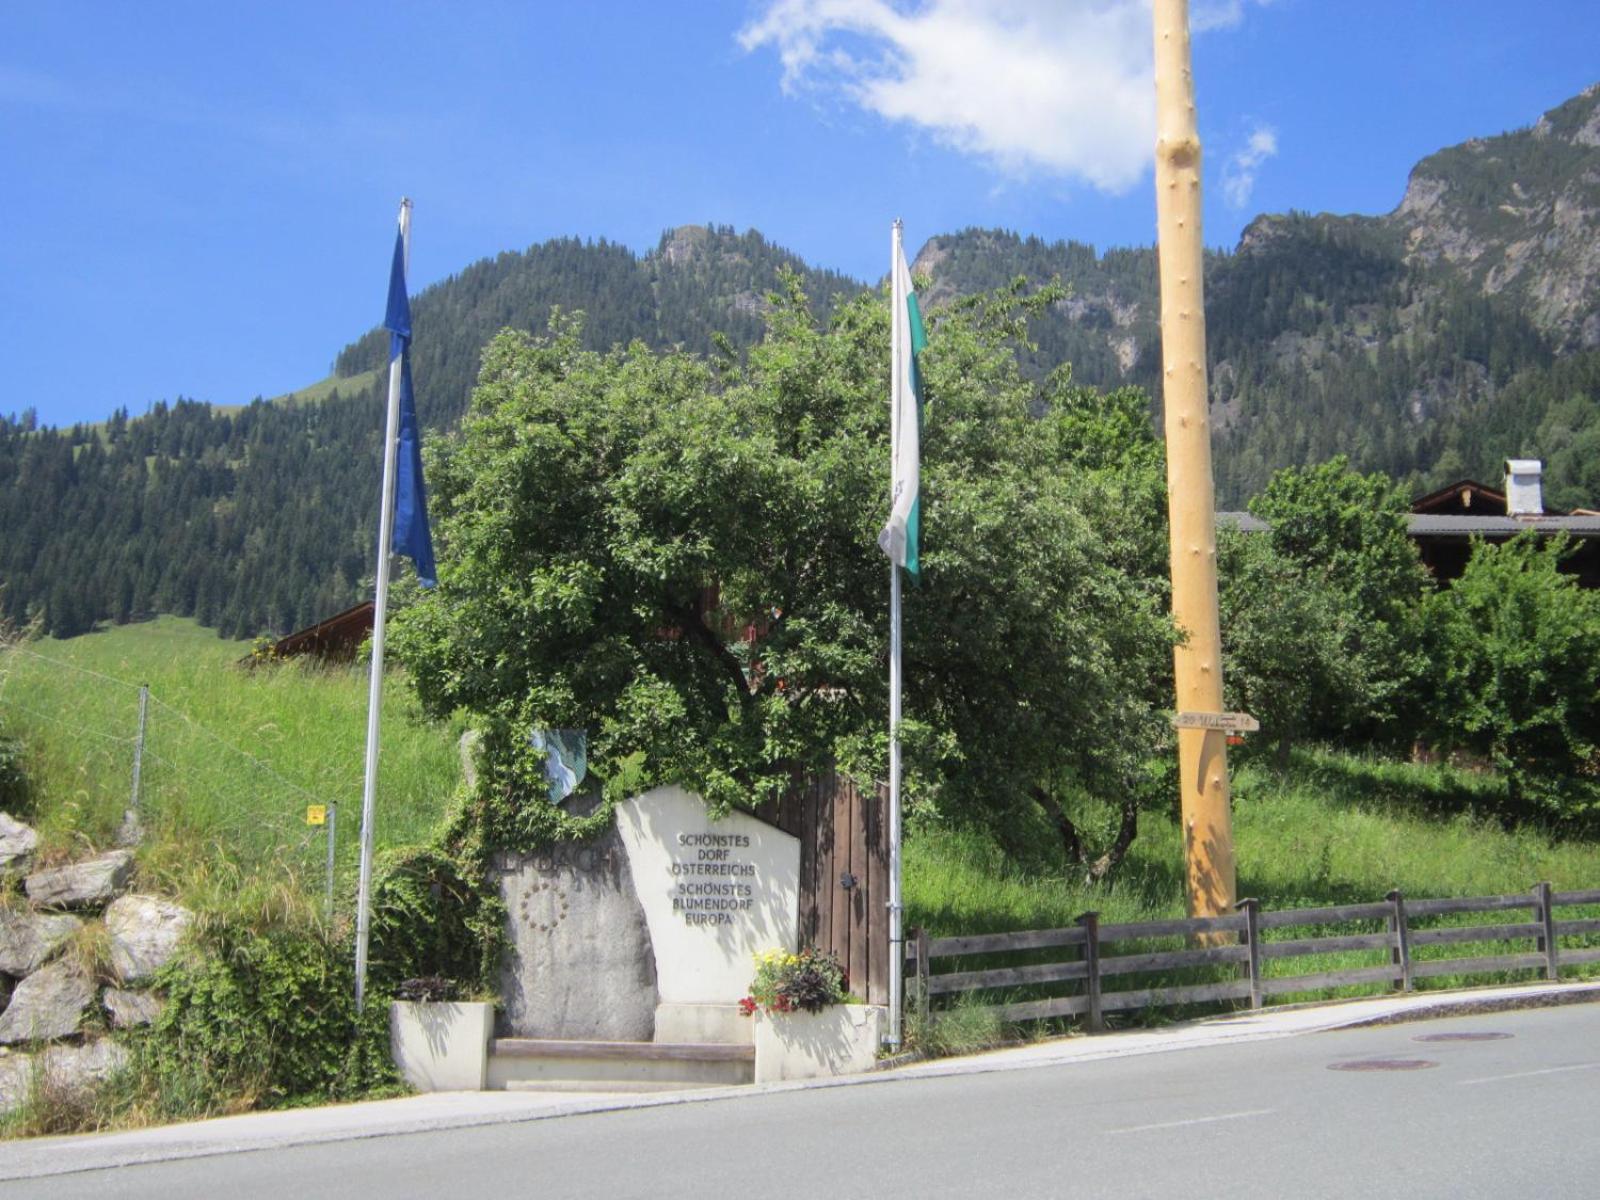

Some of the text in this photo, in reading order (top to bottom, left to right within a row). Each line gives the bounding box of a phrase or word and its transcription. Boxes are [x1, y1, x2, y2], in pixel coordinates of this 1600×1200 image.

[679, 833, 750, 847] SCHÖNSTES
[698, 849, 730, 861] DORF
[671, 862, 756, 876] ÖSTERREICHS
[678, 882, 752, 896] SCHÖNSTES
[672, 898, 753, 911] BLUMENDORF
[685, 913, 733, 926] EUROPA
